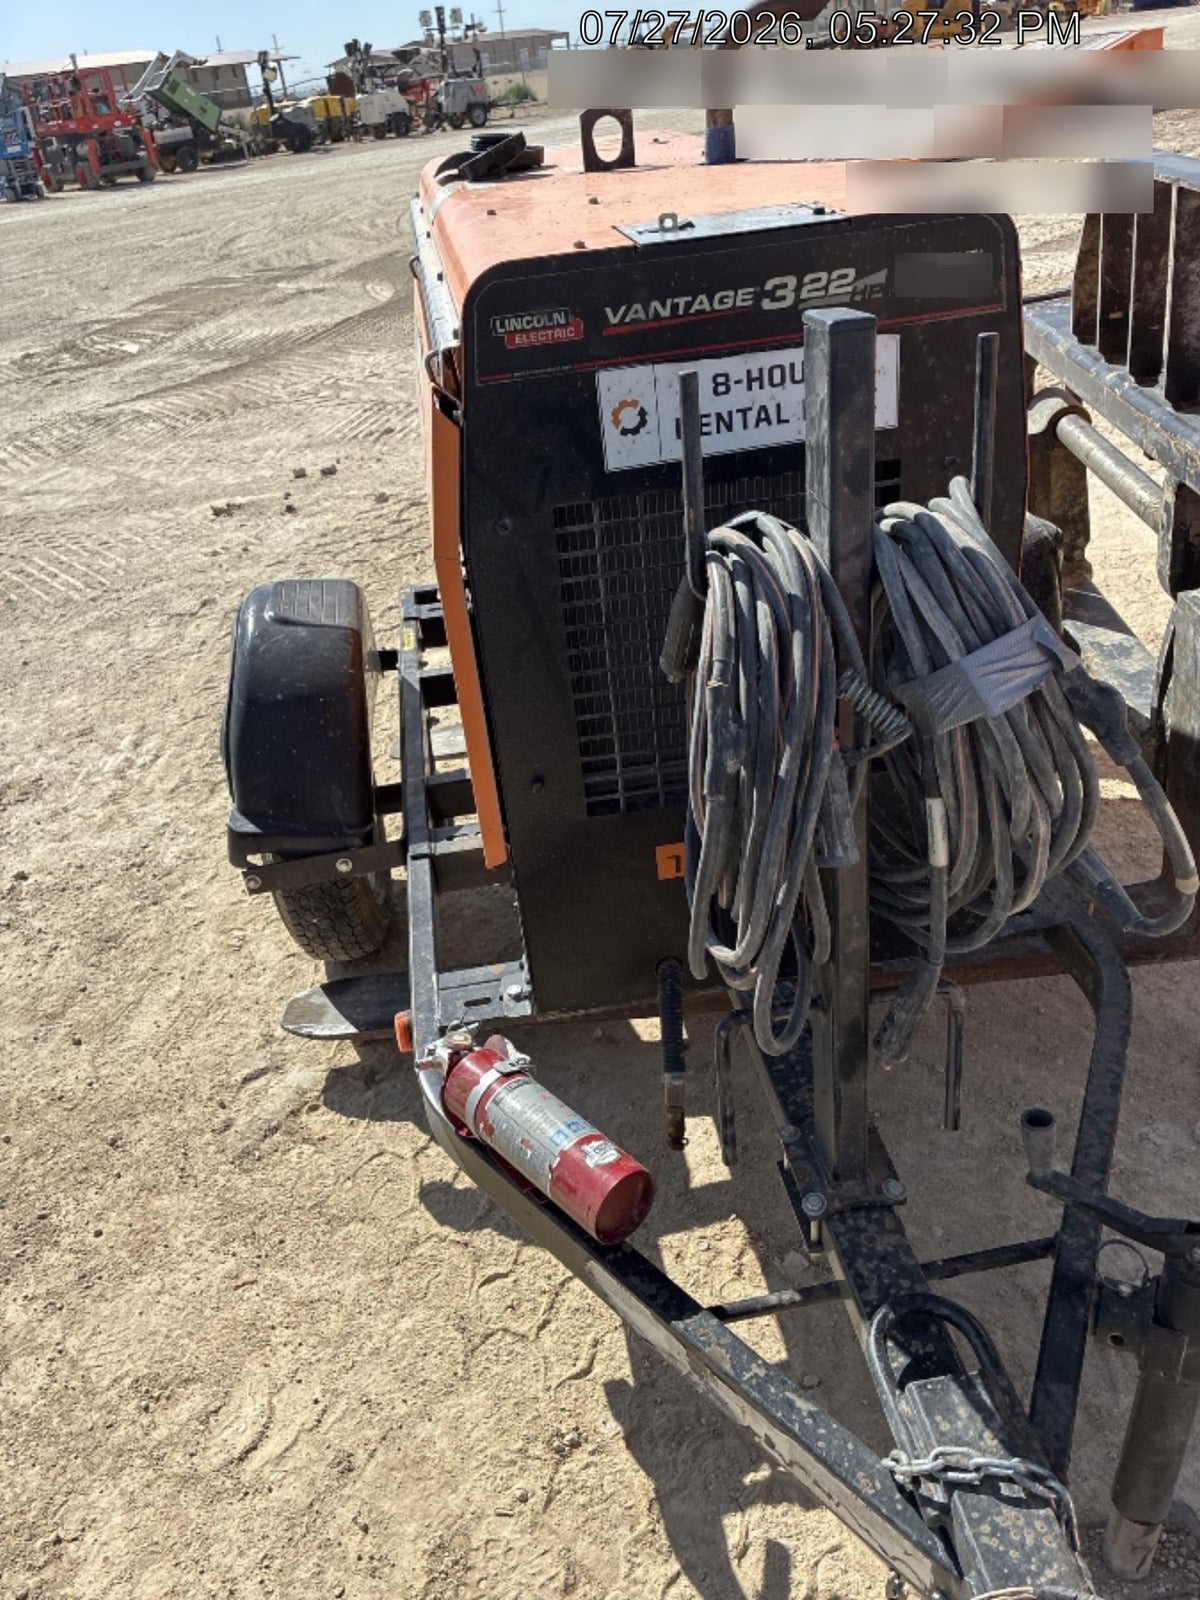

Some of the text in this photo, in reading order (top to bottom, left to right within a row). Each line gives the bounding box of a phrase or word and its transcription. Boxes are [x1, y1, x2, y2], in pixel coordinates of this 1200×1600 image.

[604, 287, 755, 324] VANTAGE
[761, 268, 856, 310] 322
[495, 311, 567, 333] LINCOLN
[515, 327, 575, 344] ELECTRIC
[712, 360, 805, 397] 8-HOU
